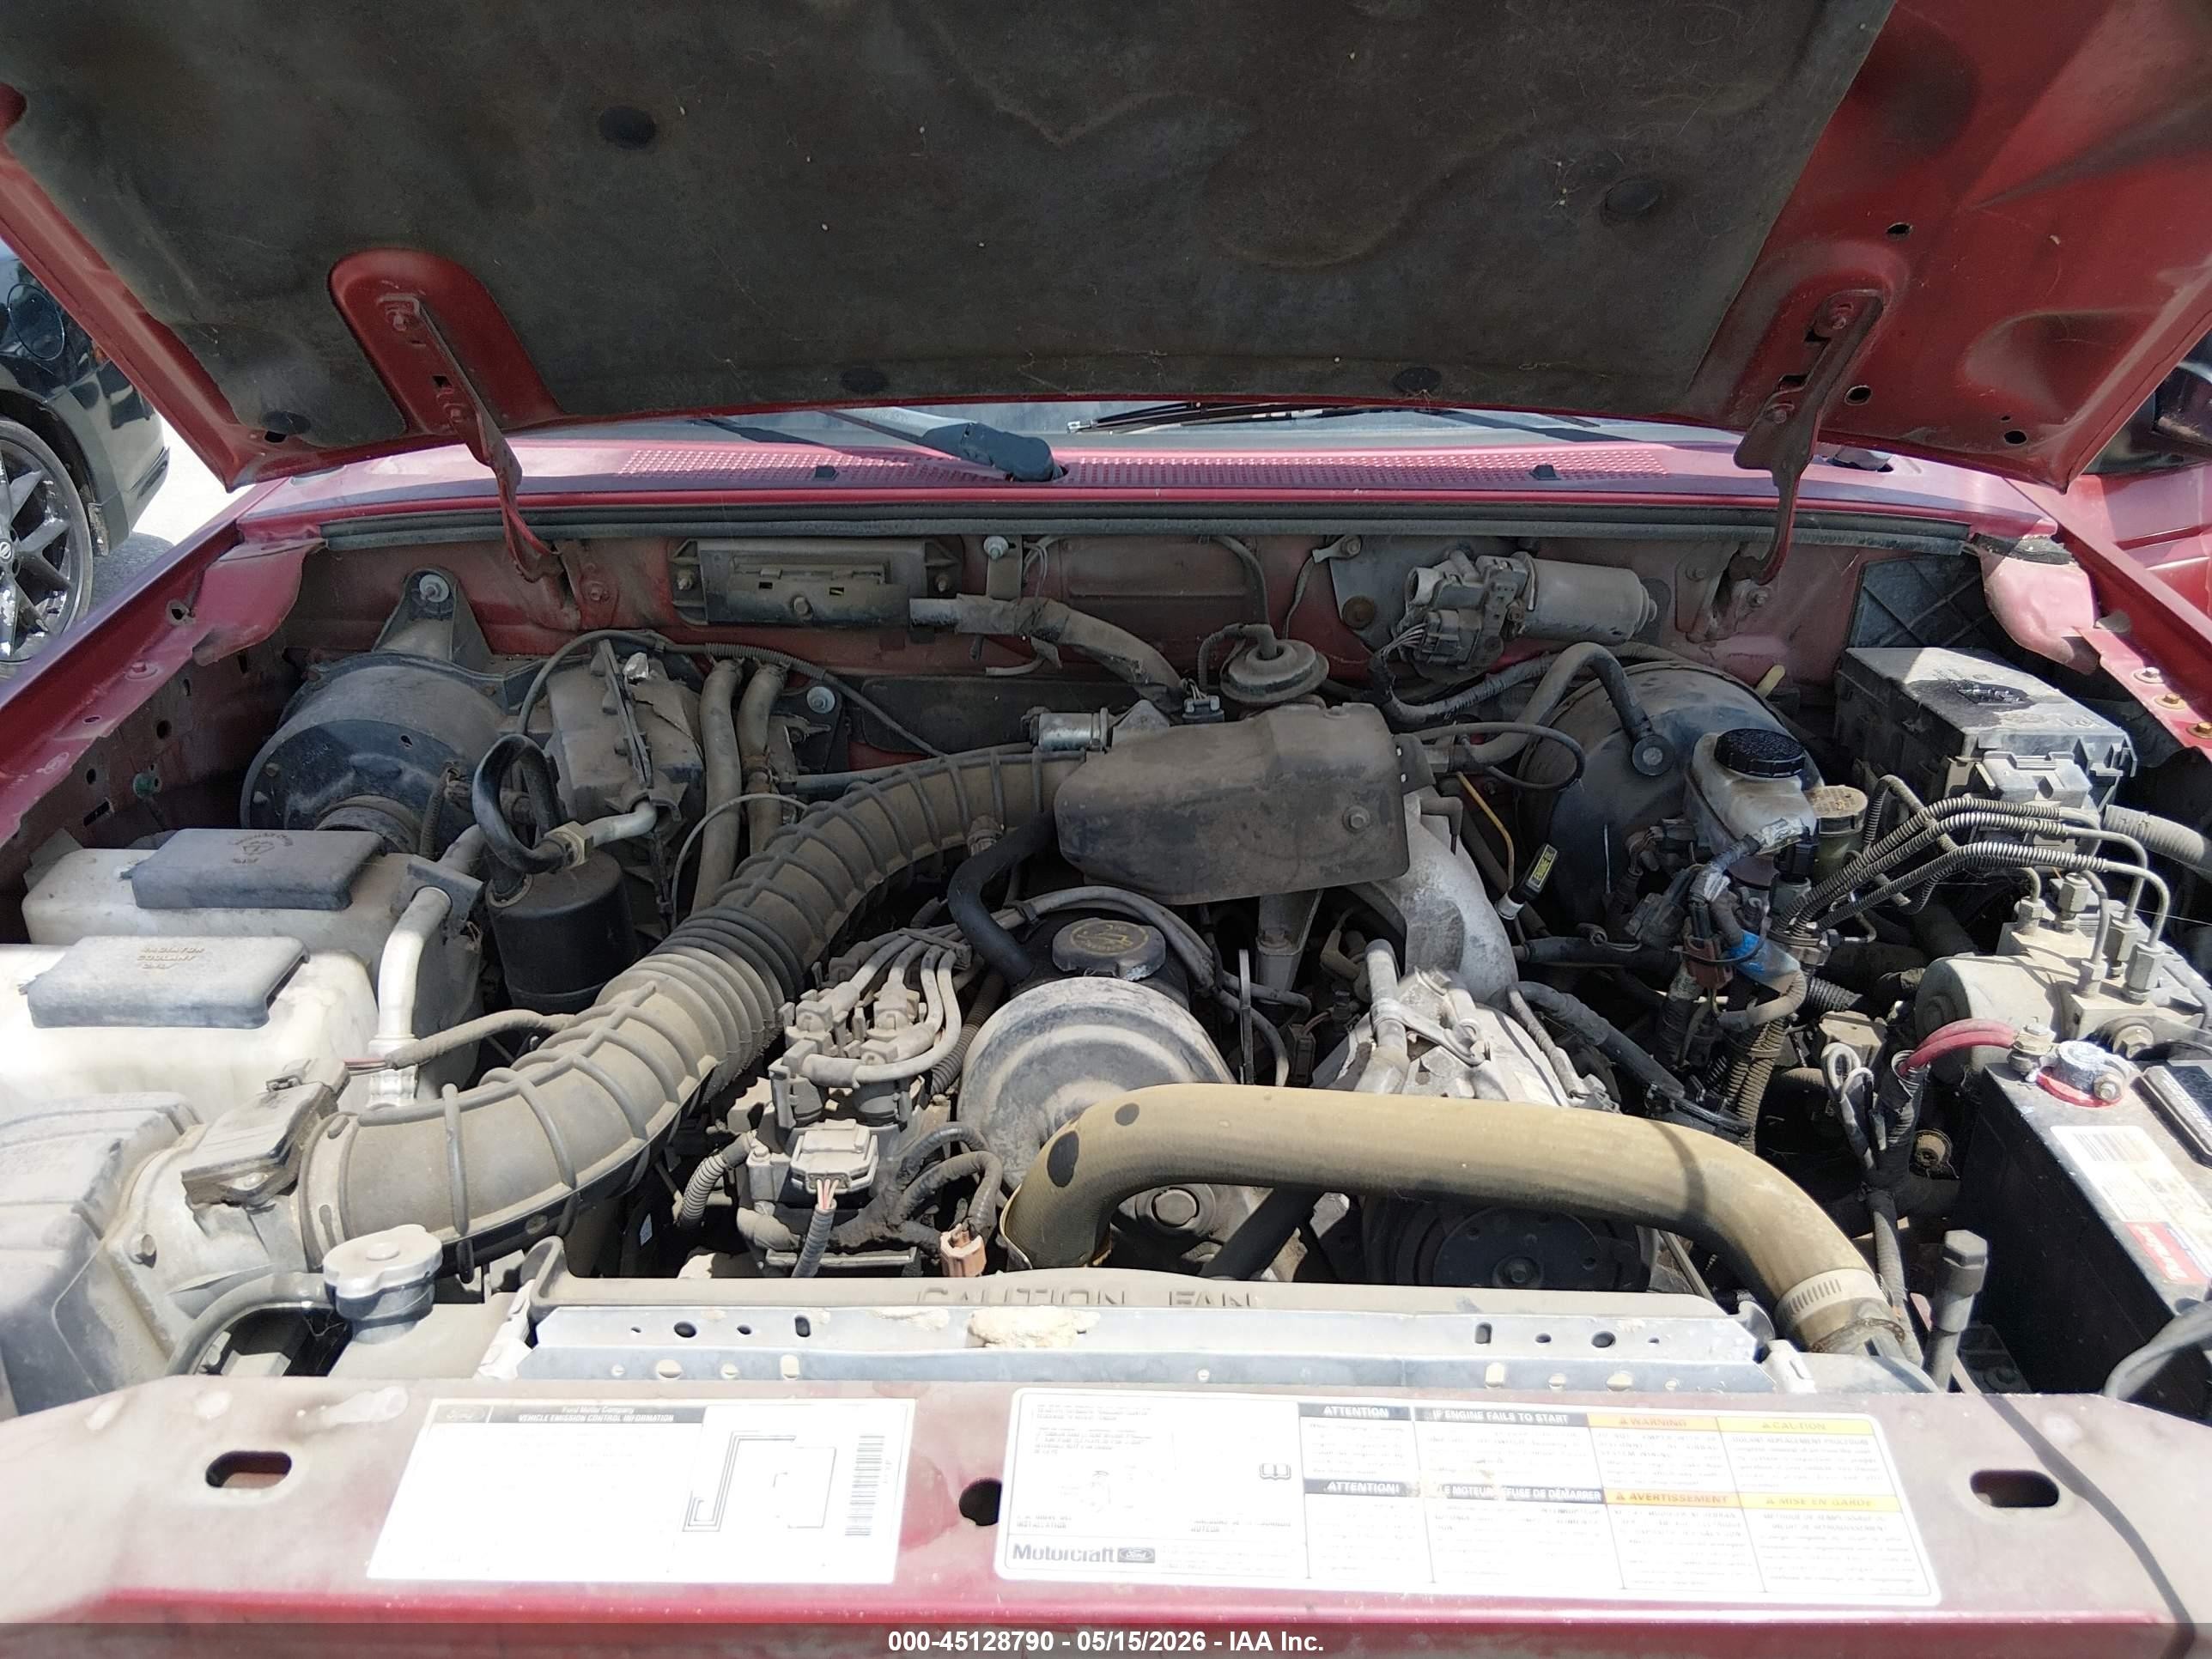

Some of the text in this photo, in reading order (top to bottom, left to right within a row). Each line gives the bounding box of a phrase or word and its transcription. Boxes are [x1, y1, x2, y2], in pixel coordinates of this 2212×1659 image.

[1169, 1290, 1252, 1308] FAN
[518, 1413, 675, 1424] VEHICLE EMISSION CONTROL INFORMATION
[1323, 1405, 1389, 1419] ATTENTION
[1431, 1409, 1569, 1425] IF ENGINE FAILS TO START
[1630, 1417, 1687, 1428] WARNING
[1328, 1480, 1400, 1495] ATTENTION!
[1532, 1488, 1547, 1500] DE
[1547, 1486, 1602, 1502] DÉMARRER
[1628, 1492, 1729, 1505] AVERTISSEMENT
[1778, 1497, 1809, 1507] MISE
[1811, 1498, 1827, 1508] EN
[1012, 1542, 1115, 1563] Motorcraft
